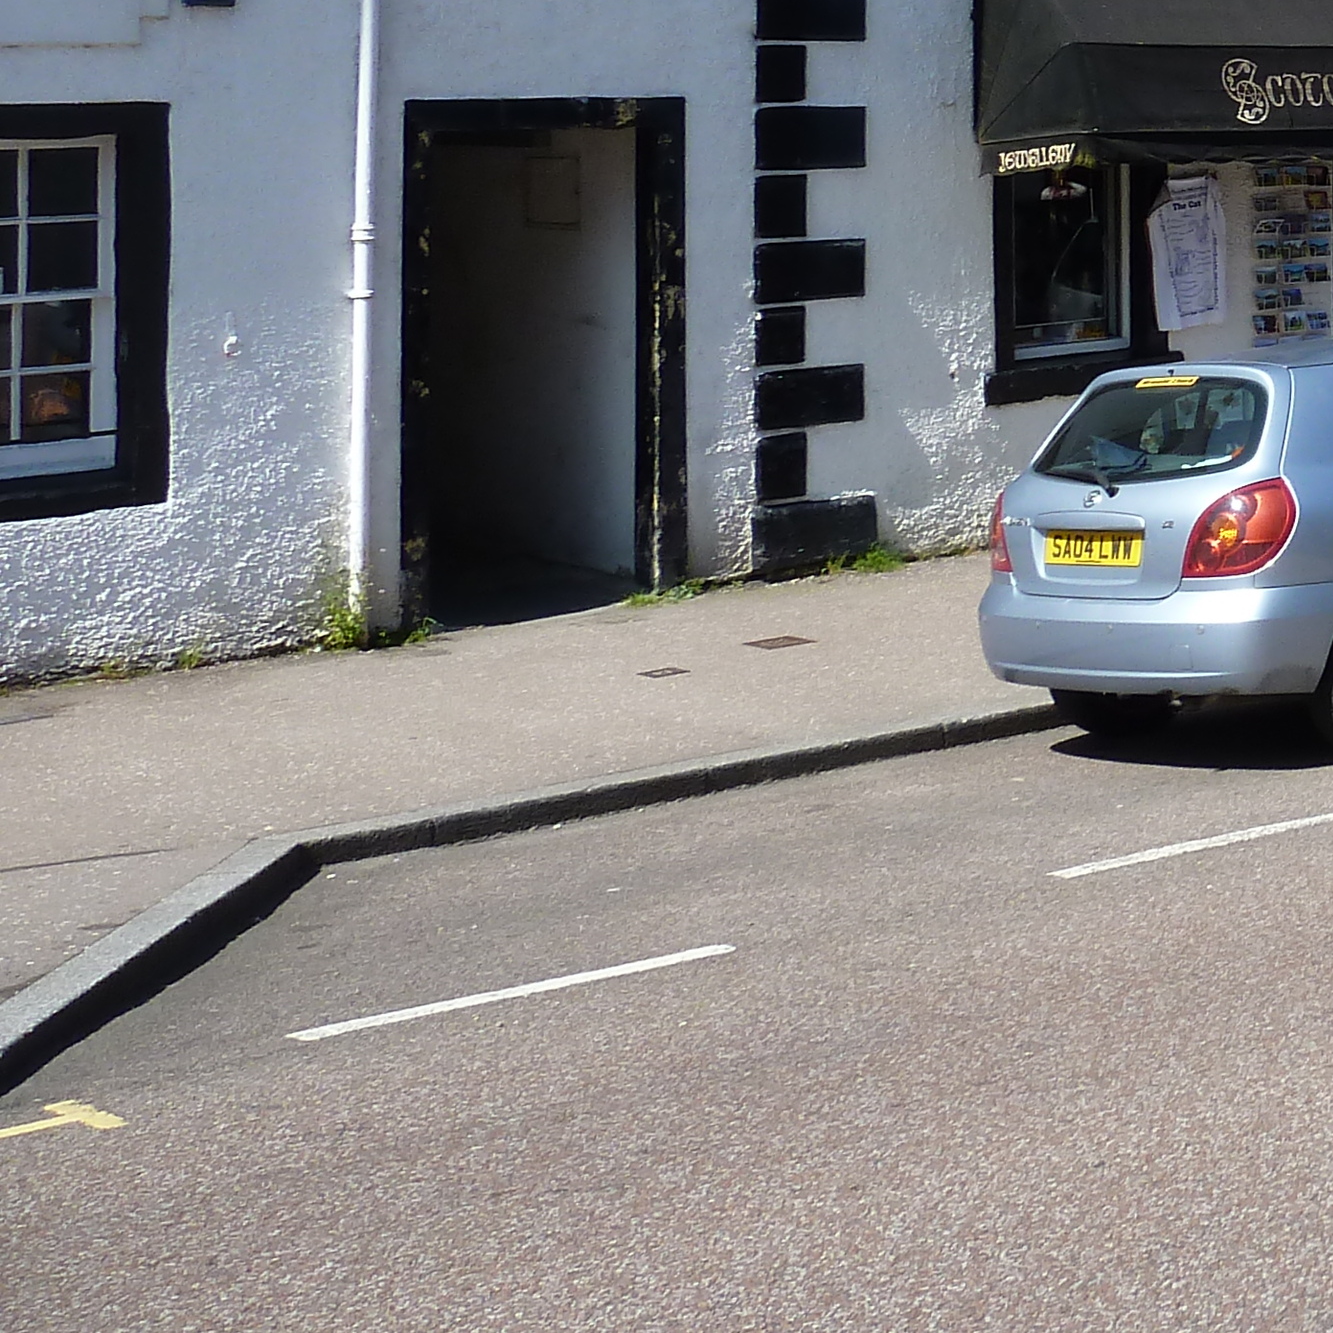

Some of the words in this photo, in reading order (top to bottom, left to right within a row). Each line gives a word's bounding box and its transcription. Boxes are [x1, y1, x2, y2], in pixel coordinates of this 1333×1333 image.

[1172, 201, 1188, 211] The
[1052, 534, 1094, 560] SA04
[1099, 535, 1135, 561] LWW
